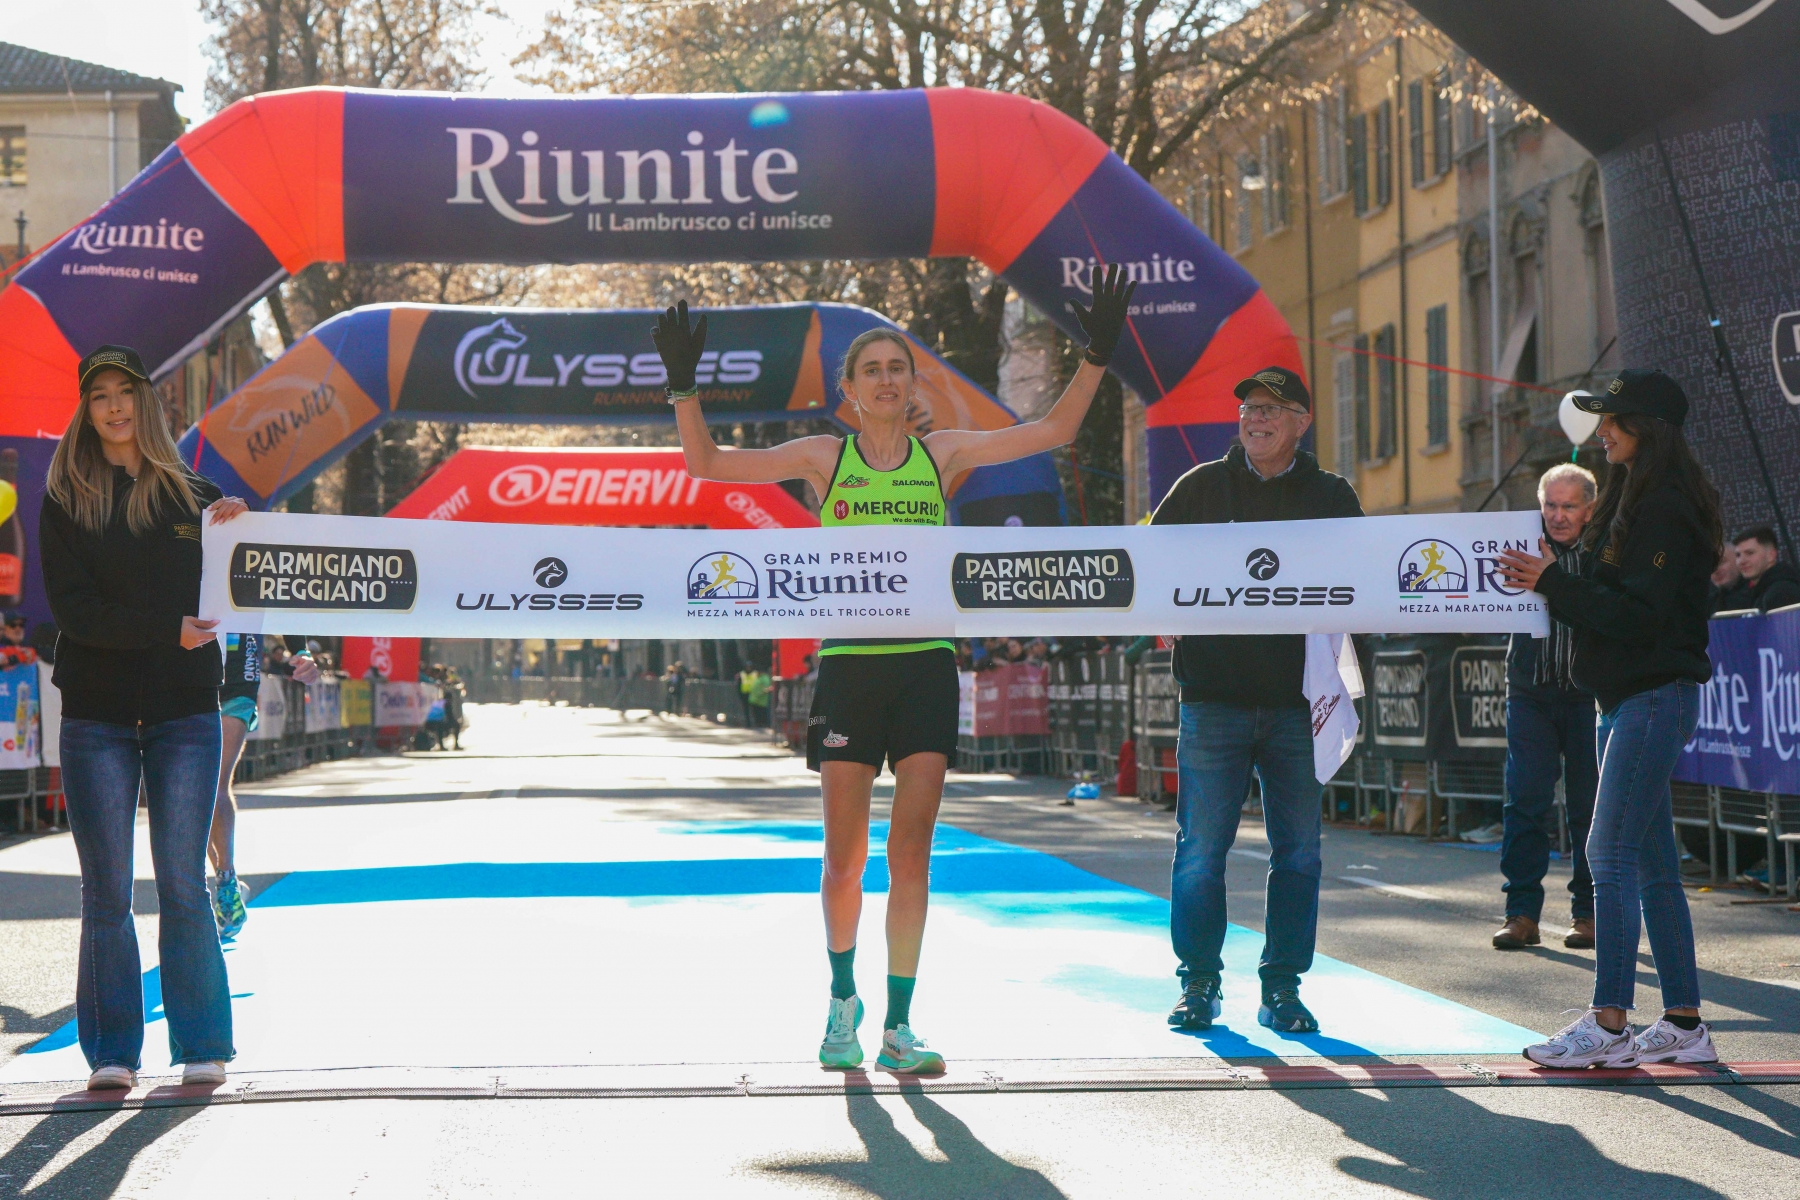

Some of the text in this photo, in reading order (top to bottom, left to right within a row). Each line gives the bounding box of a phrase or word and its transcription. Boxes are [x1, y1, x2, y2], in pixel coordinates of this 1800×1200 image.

[446, 127, 799, 225] Riunite
[610, 212, 731, 231] Lambrusco
[737, 212, 755, 230] ci
[763, 212, 832, 230] unisce
[69, 218, 204, 254] Riunite
[72, 264, 140, 280] Lambrusco
[143, 265, 155, 281] ci
[158, 268, 198, 284] unisce
[1060, 253, 1196, 294] Rinite
[1156, 301, 1197, 314] unisce
[468, 348, 764, 387] ULYSSES
[247, 411, 287, 463] RUN
[892, 479, 935, 487] SALOMON
[853, 501, 939, 517] MERCURIO
[1472, 539, 1528, 553] GRAN
[246, 550, 403, 579] PARMIGIANO
[764, 550, 908, 566] GRAN PREMIO
[966, 554, 1119, 579] PARMIGIANO
[259, 577, 387, 602] REGGIANO
[766, 568, 908, 602] Riunite
[982, 577, 1106, 602] REGGIANO
[456, 593, 644, 611] ULYSSES
[1173, 586, 1355, 607] ULYSSES
[687, 608, 911, 617] MEZZA MARATONA DEL TRICOLORE
[1399, 603, 1540, 613] MEZZA MARATONA DEL
